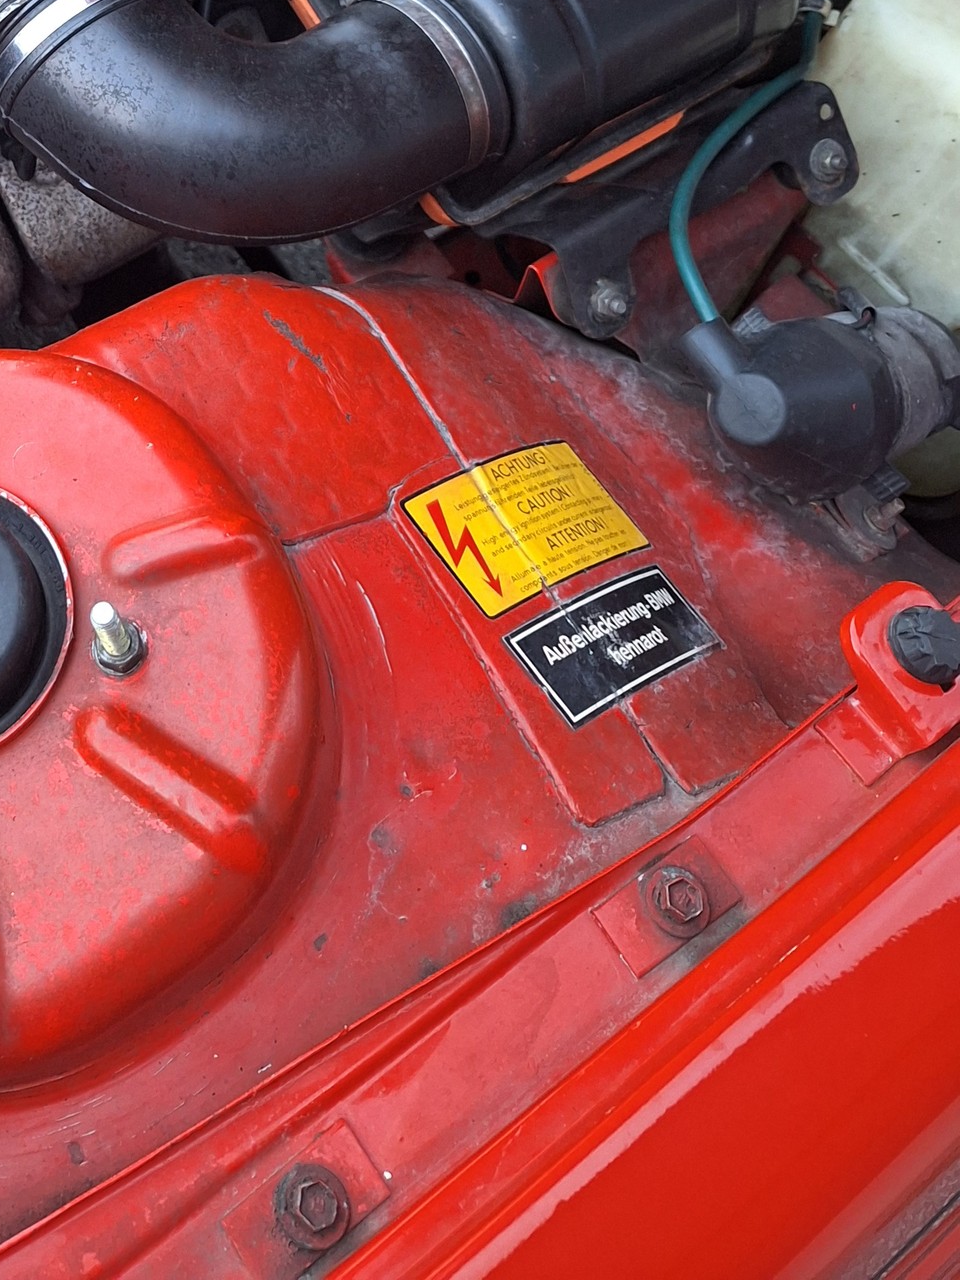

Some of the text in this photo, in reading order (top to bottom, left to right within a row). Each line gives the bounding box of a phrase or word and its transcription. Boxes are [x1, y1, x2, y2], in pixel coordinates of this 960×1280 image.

[490, 450, 550, 482] ACHTUNG!
[517, 484, 575, 515] CAUTION!
[480, 534, 500, 547] High
[545, 516, 609, 551] ATTENTION!
[489, 546, 506, 556] and
[509, 563, 543, 581] Allumae
[541, 587, 676, 666] Außenlackierung-BMW
[607, 624, 669, 666] hennarot
